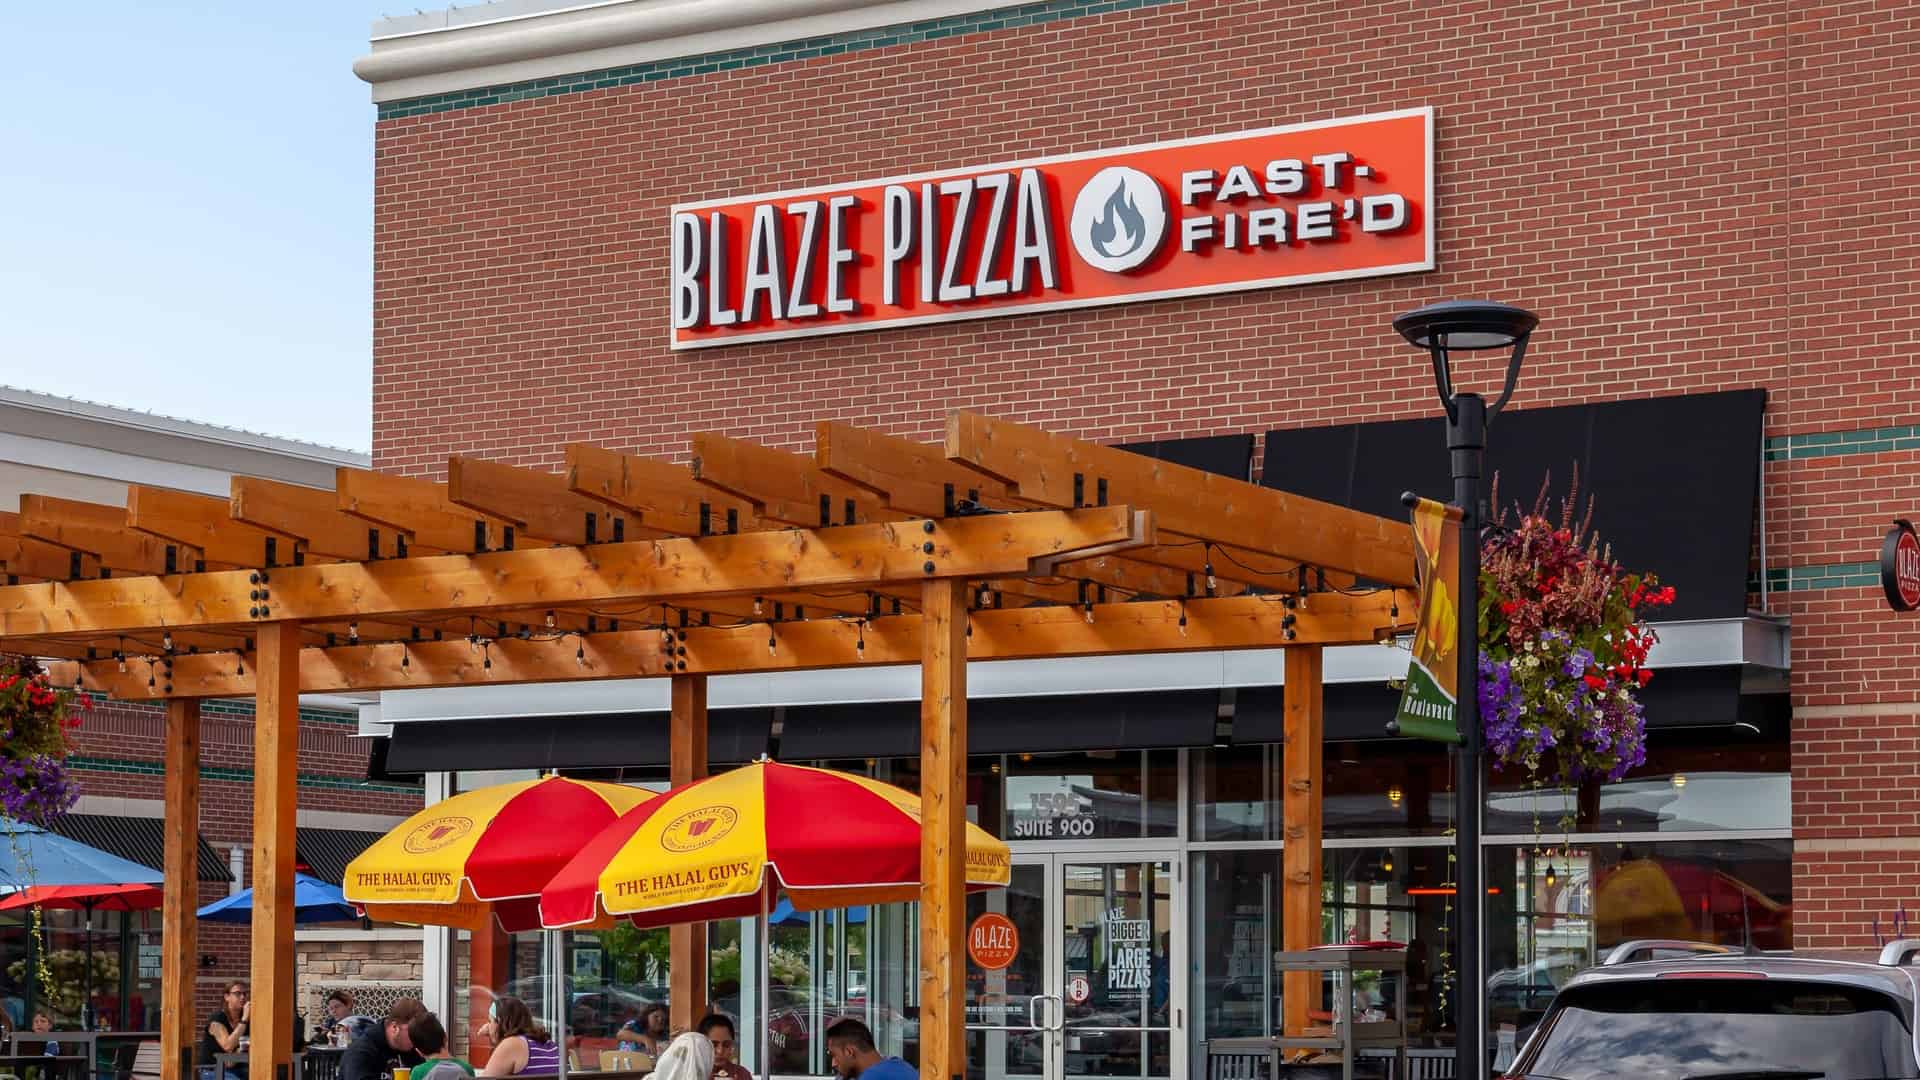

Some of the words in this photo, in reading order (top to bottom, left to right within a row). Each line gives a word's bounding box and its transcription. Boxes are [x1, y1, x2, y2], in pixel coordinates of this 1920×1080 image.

[1181, 152, 1370, 206] FAST-
[1181, 193, 1406, 253] FIRE'D
[674, 195, 855, 329] BLAZE
[883, 167, 1056, 305] PIZZA
[1404, 695, 1453, 720] Boulevard
[1015, 818, 1053, 837] SUITE
[1060, 818, 1095, 837] 900
[357, 873, 381, 887] THE
[383, 872, 420, 886] HALAL
[615, 878, 649, 897] THE
[652, 869, 705, 891] HALAL
[975, 924, 1012, 950] BLAZE
[1111, 922, 1149, 940] BIGGER
[976, 950, 1010, 958] PIZZA
[1109, 945, 1151, 969] LARGE
[1108, 969, 1151, 989] PIZZAS
